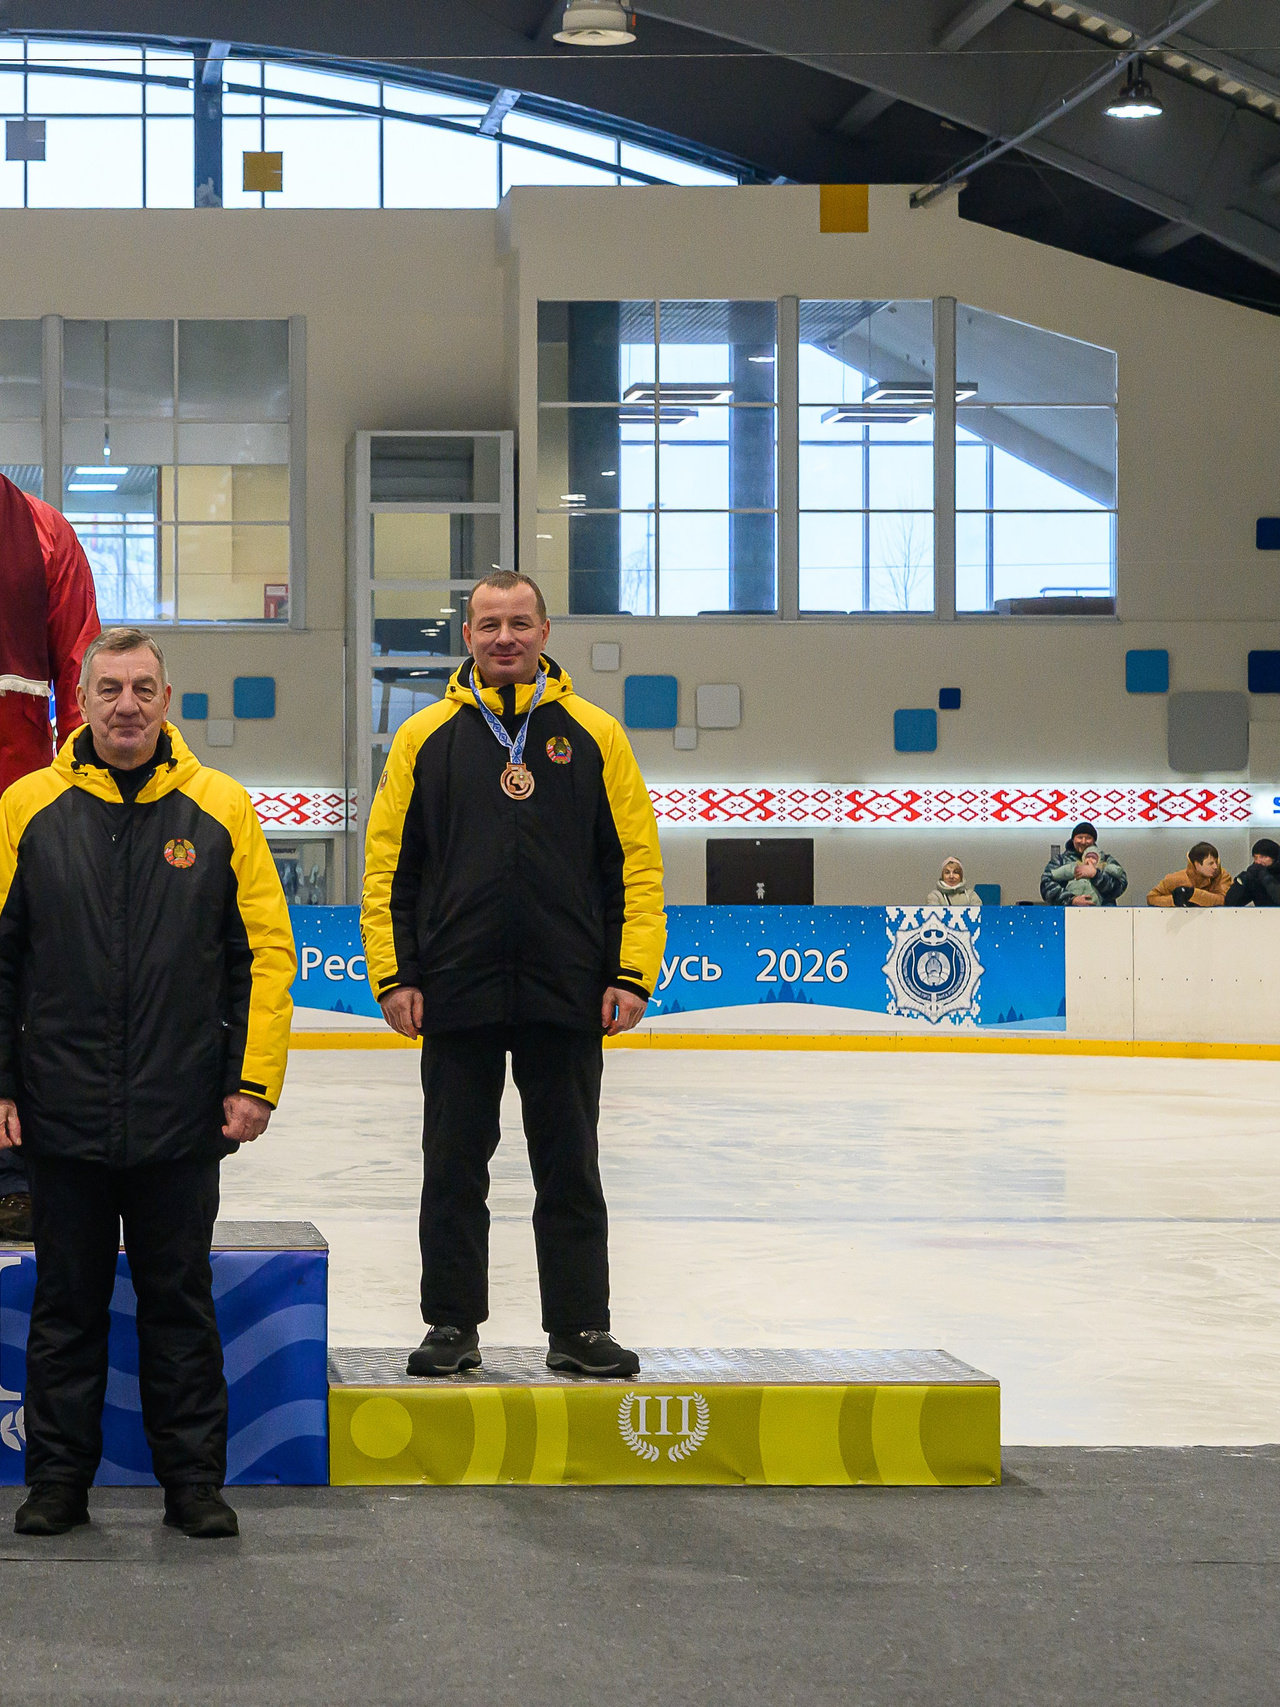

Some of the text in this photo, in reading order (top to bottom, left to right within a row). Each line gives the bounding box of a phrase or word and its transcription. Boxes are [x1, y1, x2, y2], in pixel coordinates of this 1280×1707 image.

[301, 946, 366, 981] Рес
[756, 948, 849, 983] 2026
[634, 1396, 695, 1436] III
